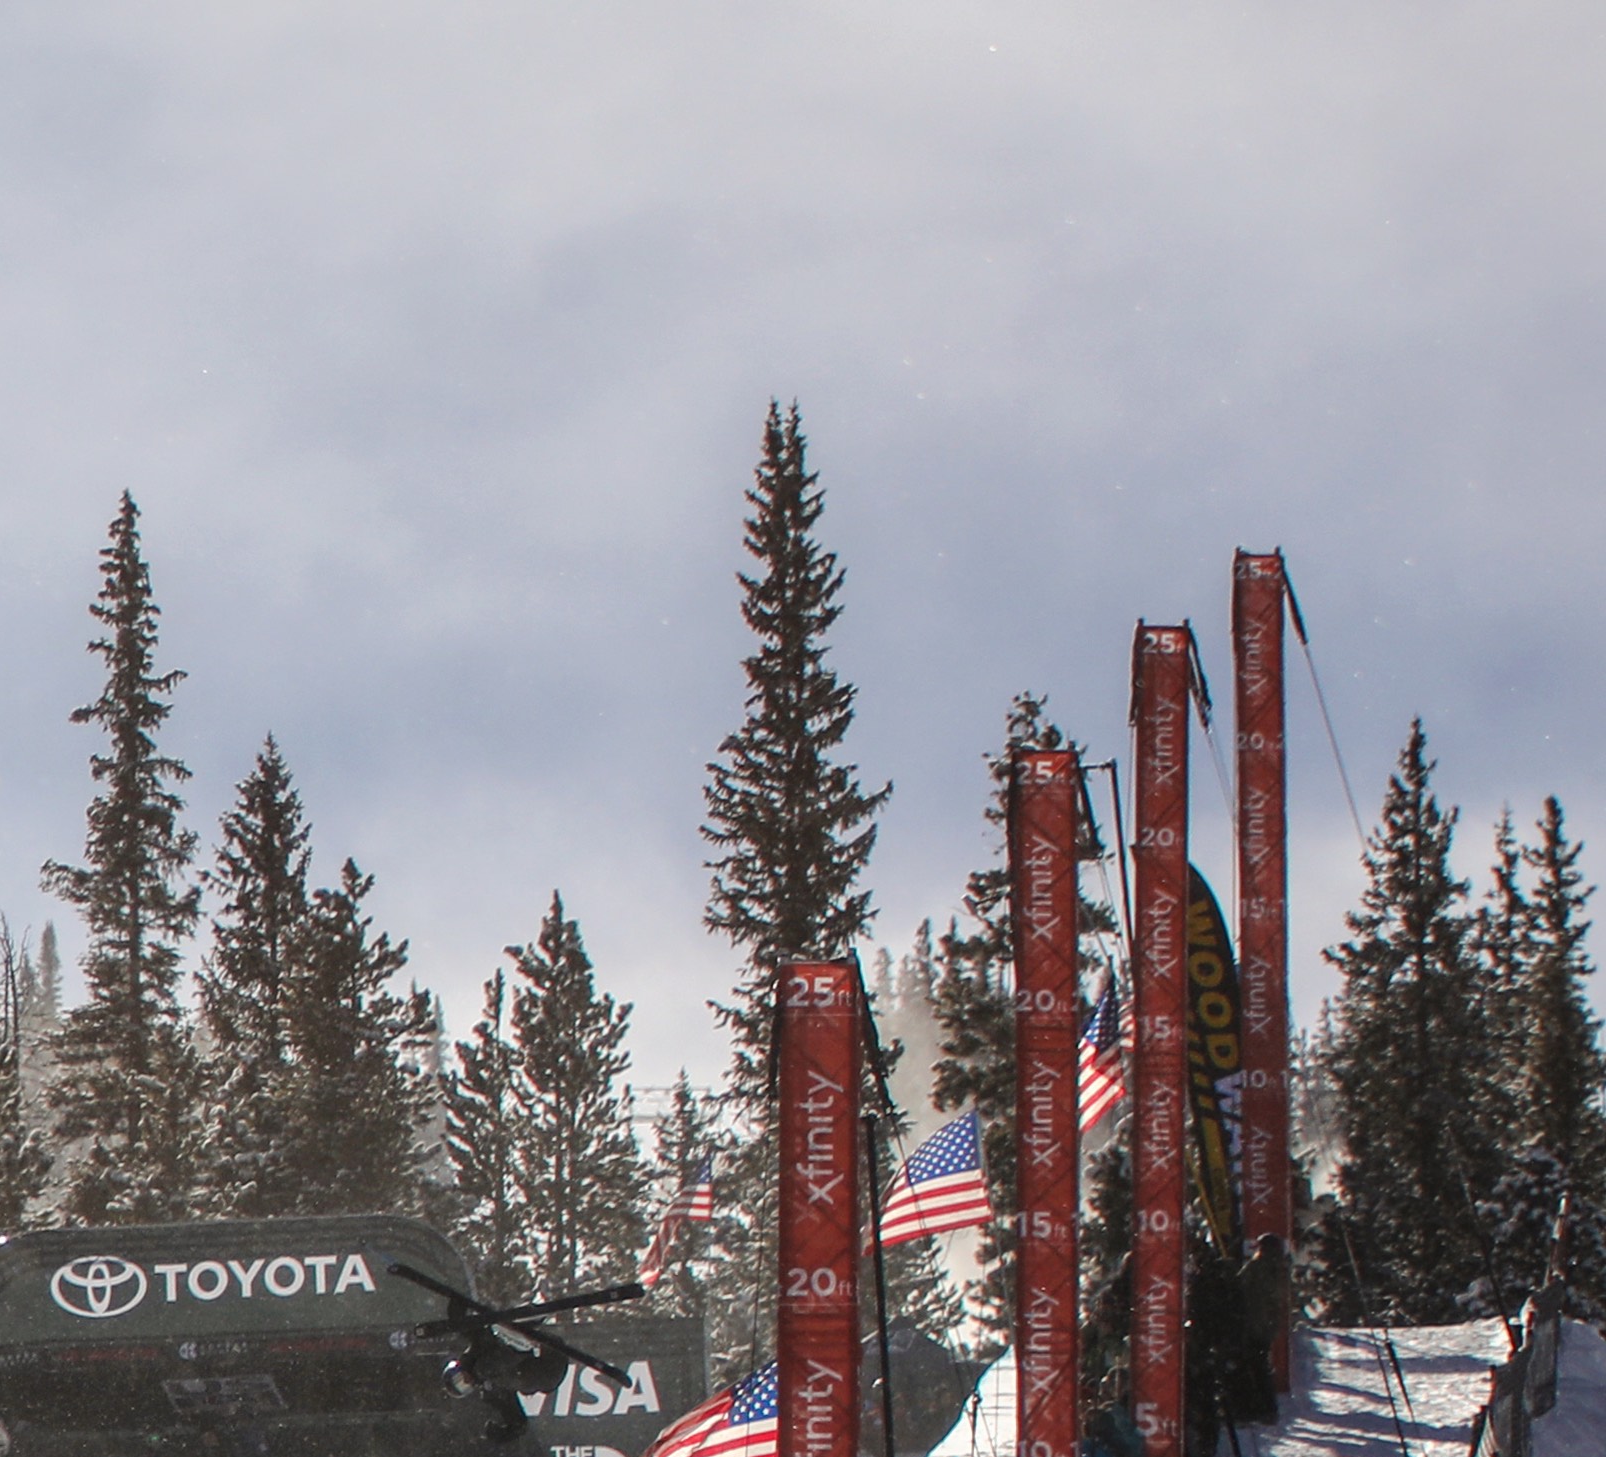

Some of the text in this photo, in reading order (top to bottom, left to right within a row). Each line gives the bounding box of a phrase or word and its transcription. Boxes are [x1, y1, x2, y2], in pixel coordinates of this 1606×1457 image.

[1142, 632, 1175, 654] 25
[1144, 697, 1181, 787] xfinity
[1141, 827, 1175, 847] 20
[1022, 834, 1061, 942] xfinity
[1145, 888, 1179, 981] xfinity
[786, 977, 835, 1008] 25
[1016, 989, 1056, 1012] 20
[1243, 954, 1272, 1036] xfinity
[795, 1070, 845, 1206] xfinity
[1022, 1060, 1061, 1169] xfinity
[1144, 1079, 1177, 1171] xfinity
[1016, 1210, 1052, 1239] 15
[1137, 1209, 1170, 1233] 10
[154, 1253, 376, 1302] TOYOTA
[786, 1266, 837, 1297] 20
[1022, 1287, 1060, 1396] xfinity
[1141, 1274, 1174, 1365] xfinity
[1136, 1402, 1158, 1437] 5
